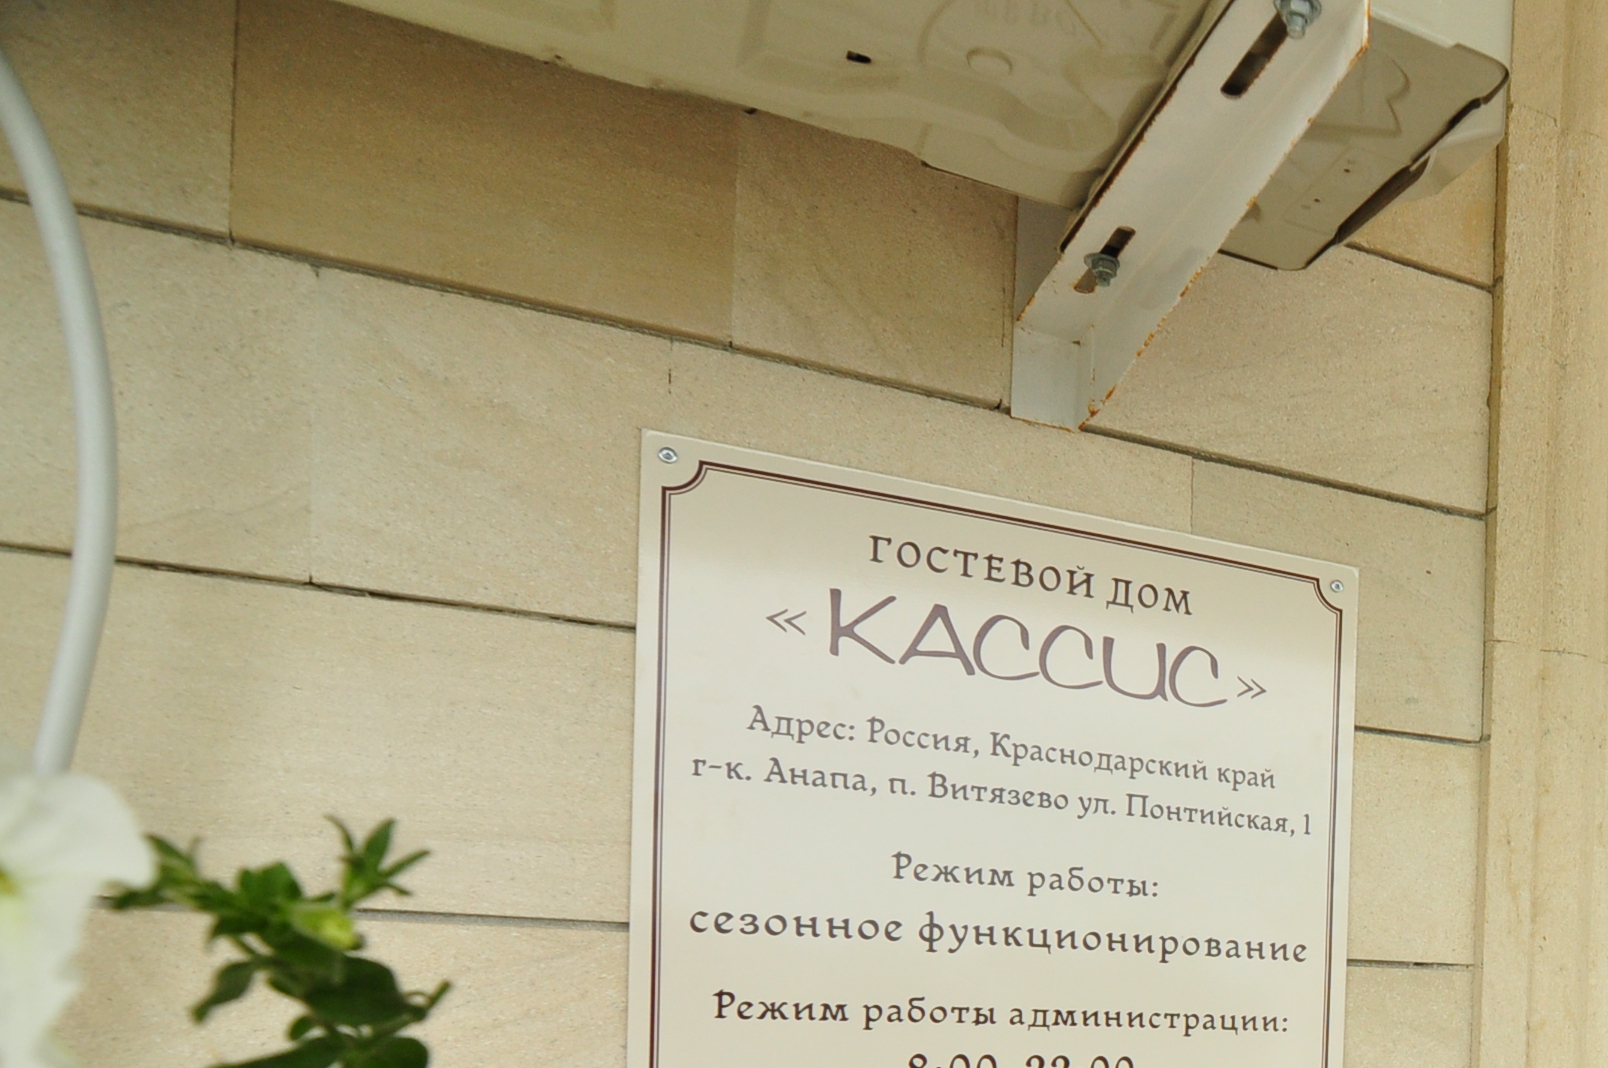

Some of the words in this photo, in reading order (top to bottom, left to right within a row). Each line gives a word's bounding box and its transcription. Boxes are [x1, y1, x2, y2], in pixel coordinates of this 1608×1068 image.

[869, 535, 1094, 598] ГОСТЕВОЙ
[1106, 578, 1192, 615] ДОМ
[747, 705, 854, 744] Адрес:
[867, 716, 979, 758] Россия,
[990, 732, 1208, 780] Краснодарский
[1217, 768, 1275, 791] край
[692, 757, 751, 782] г-к.
[764, 757, 876, 796] Анапа,
[889, 778, 916, 795] п.
[928, 772, 1068, 810] Витязево
[1077, 796, 1116, 819] ул.
[1126, 794, 1294, 837] Понтийская,
[891, 851, 1014, 887] Режим
[1027, 867, 1158, 897] работы:
[690, 909, 902, 941] сезонное
[918, 911, 1307, 963] функционирование
[713, 989, 849, 1021] Режим
[863, 997, 996, 1030] работы
[1010, 1008, 1288, 1037] администрации:
